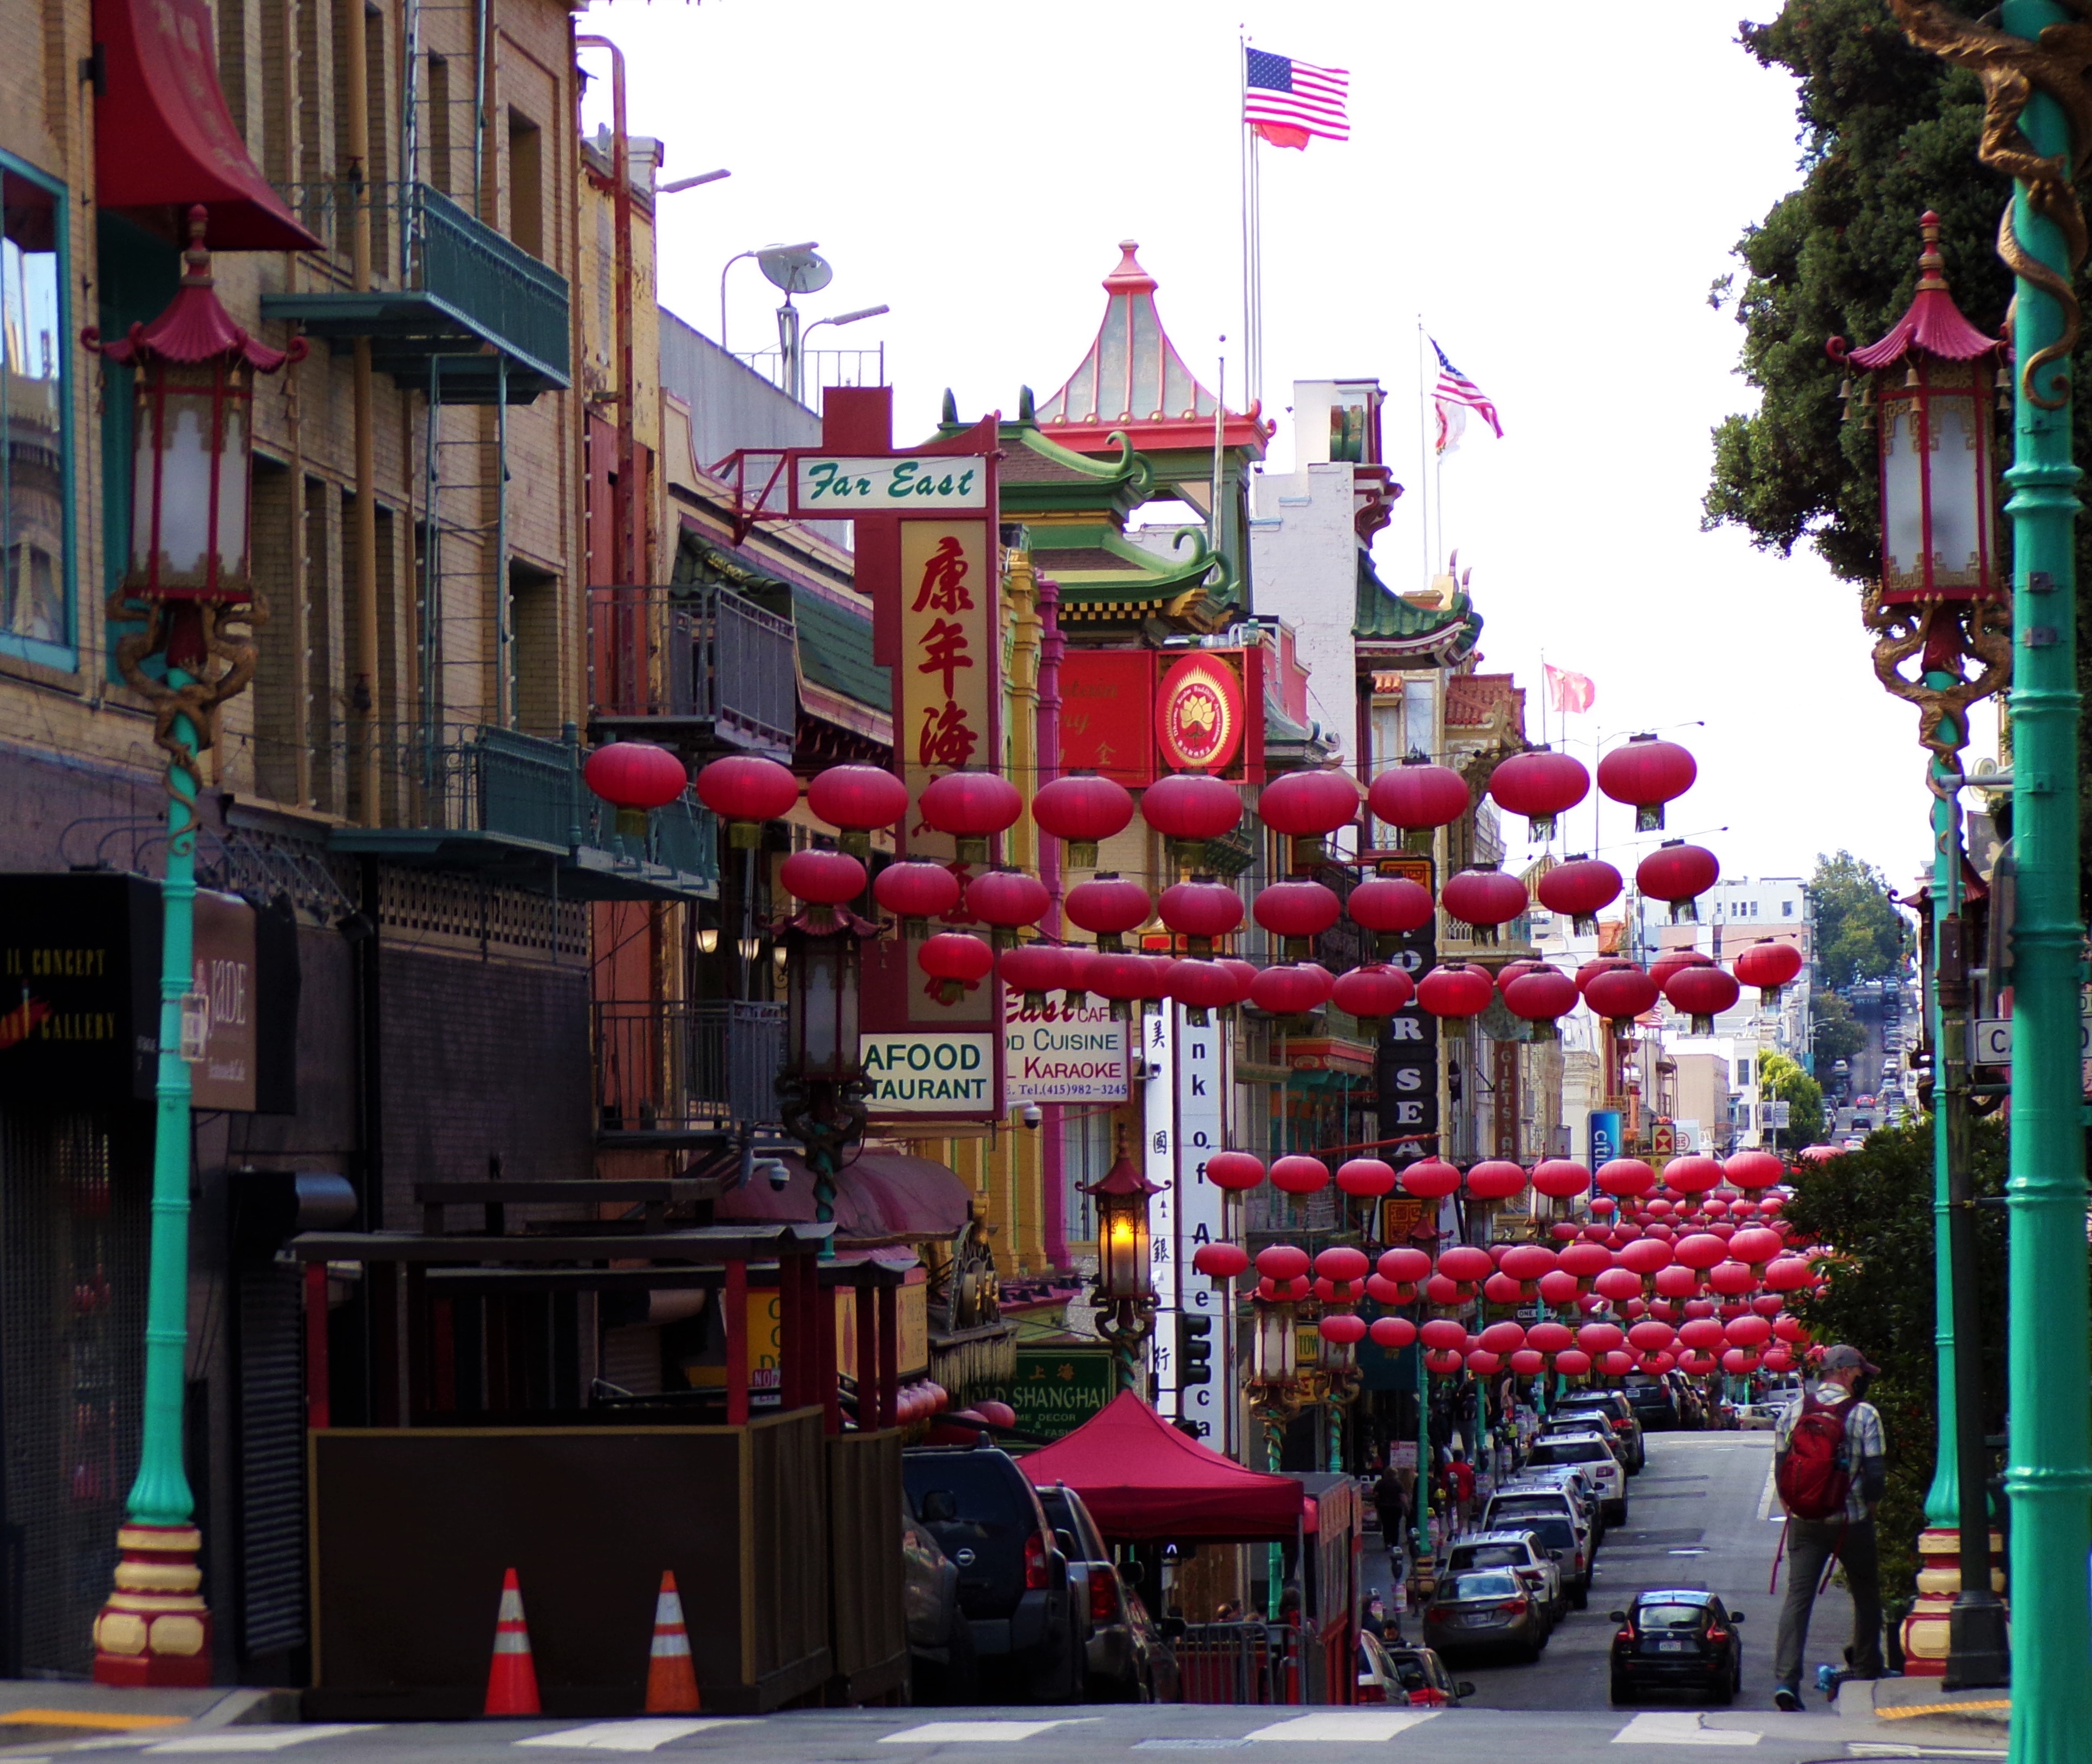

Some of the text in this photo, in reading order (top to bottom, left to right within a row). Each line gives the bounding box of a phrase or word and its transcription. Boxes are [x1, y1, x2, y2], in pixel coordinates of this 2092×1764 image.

[808, 461, 974, 500] Far East
[33, 948, 106, 976] CONCEPT
[41, 1011, 115, 1041] GALLERY
[1034, 1028, 1119, 1050] CUISINE
[862, 1043, 981, 1071] AFOOD
[1024, 1056, 1121, 1078] KARAOKE
[861, 1078, 987, 1100] TAURANT
[1500, 1050, 1512, 1119] GIFTS
[1193, 1131, 1207, 1184] of
[1298, 1334, 1318, 1355] TOW
[1012, 1385, 1106, 1409] SHANGHAI
[1016, 1413, 1076, 1422] ME DECOR
